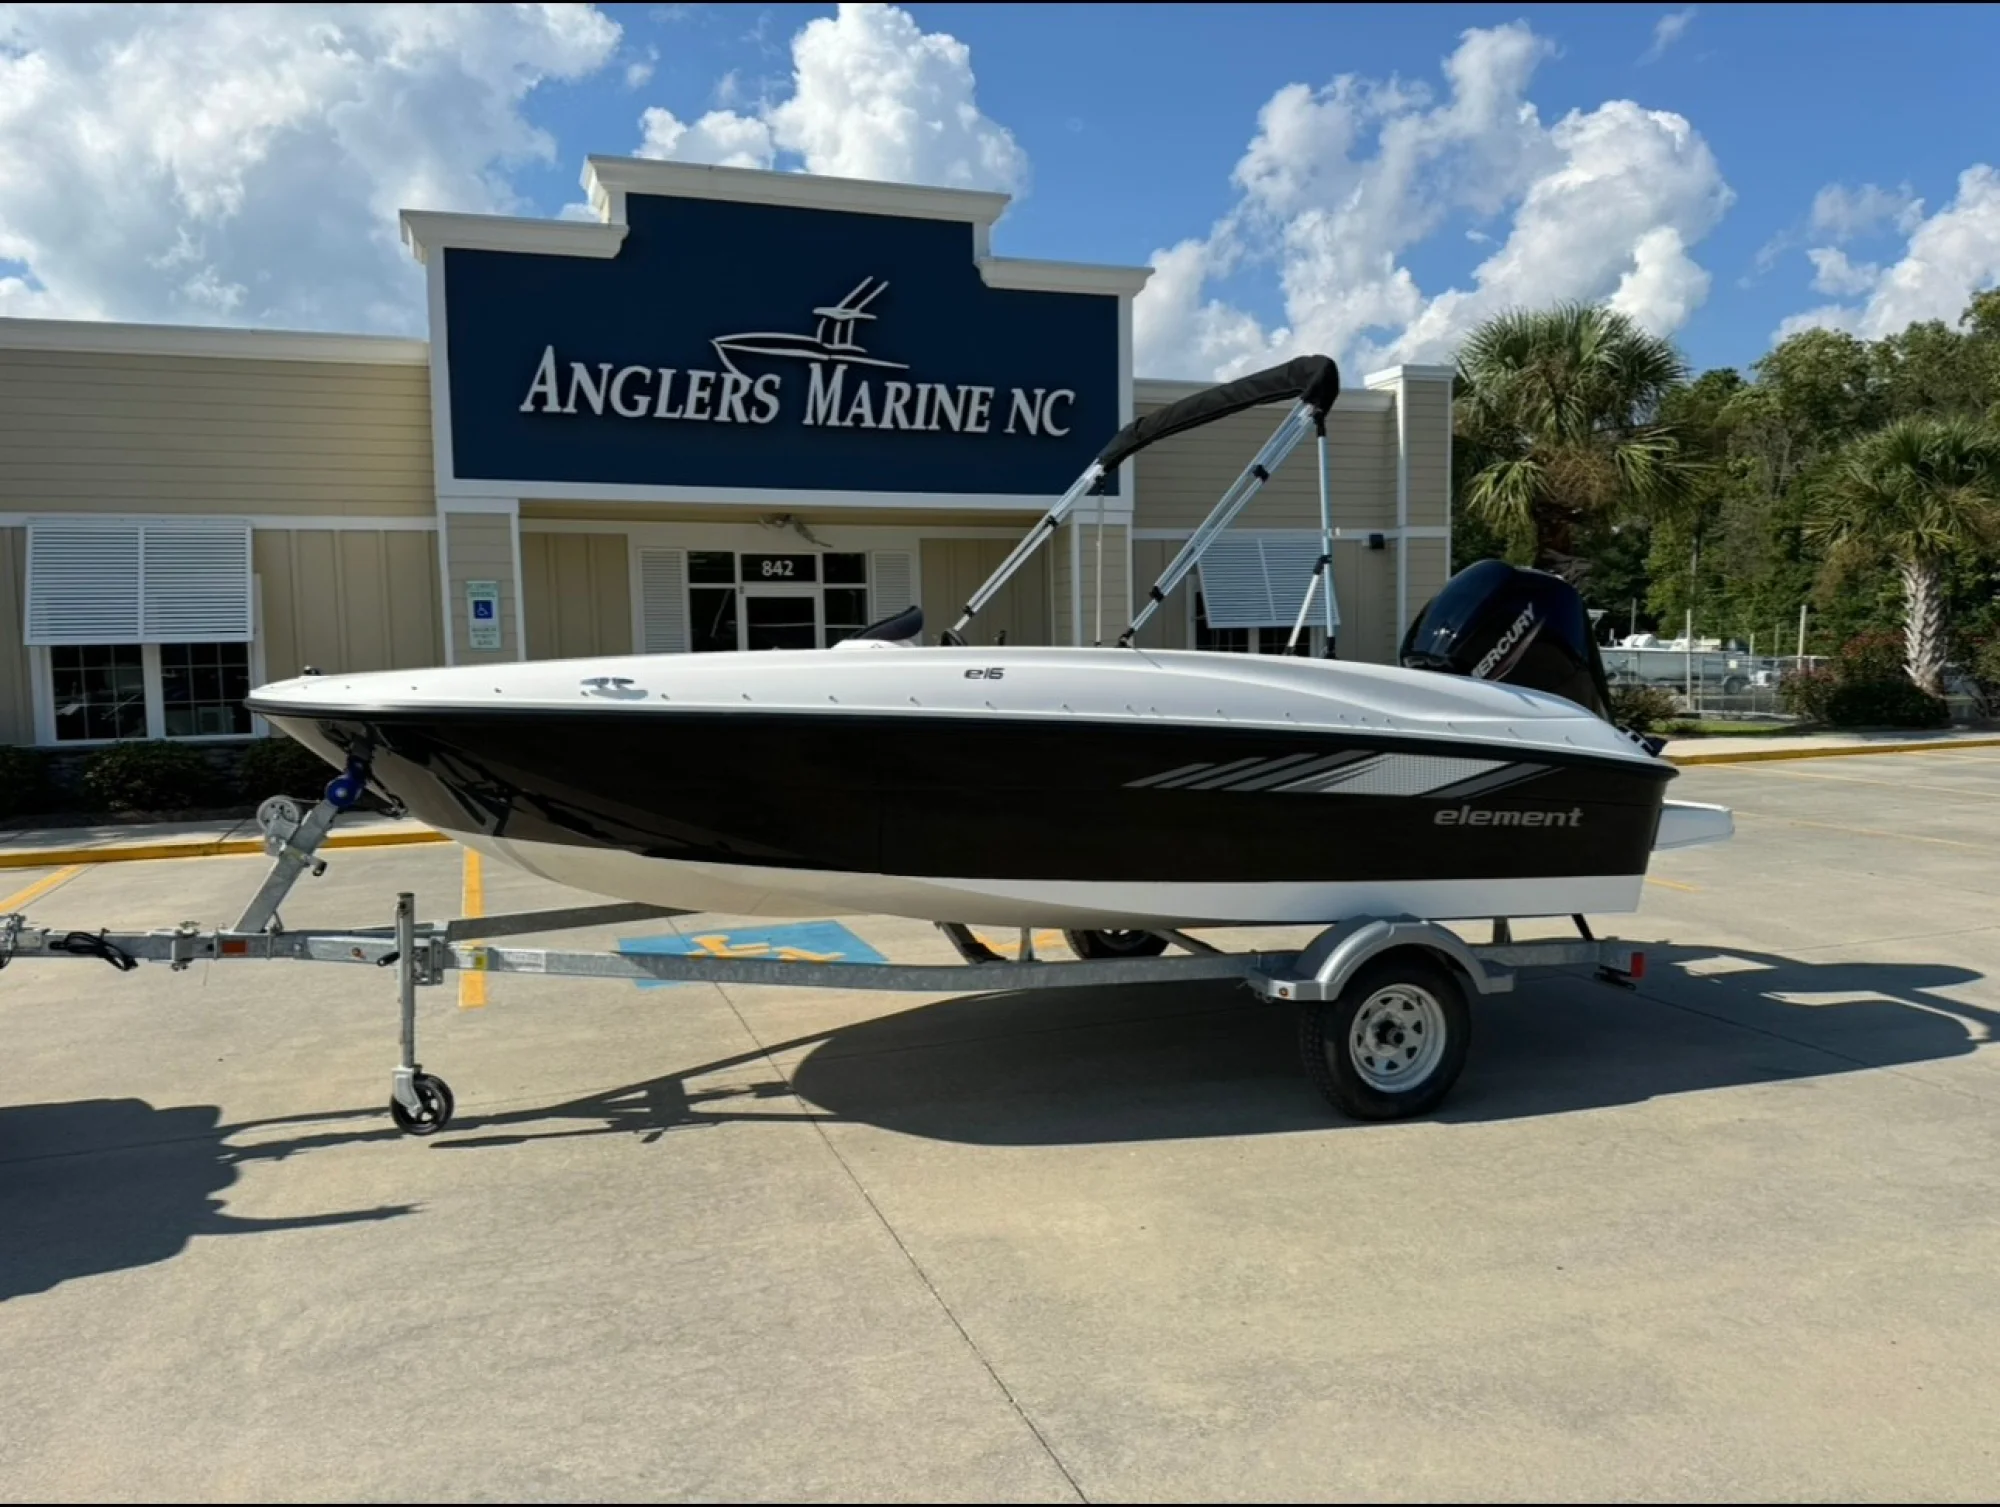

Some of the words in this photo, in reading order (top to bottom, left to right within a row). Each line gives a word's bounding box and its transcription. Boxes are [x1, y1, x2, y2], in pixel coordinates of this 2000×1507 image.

[520, 345, 780, 424] ANGLERS
[802, 363, 994, 433] MARINE
[1004, 388, 1076, 437] NC
[761, 560, 795, 576] 842
[1433, 805, 1583, 827] element
